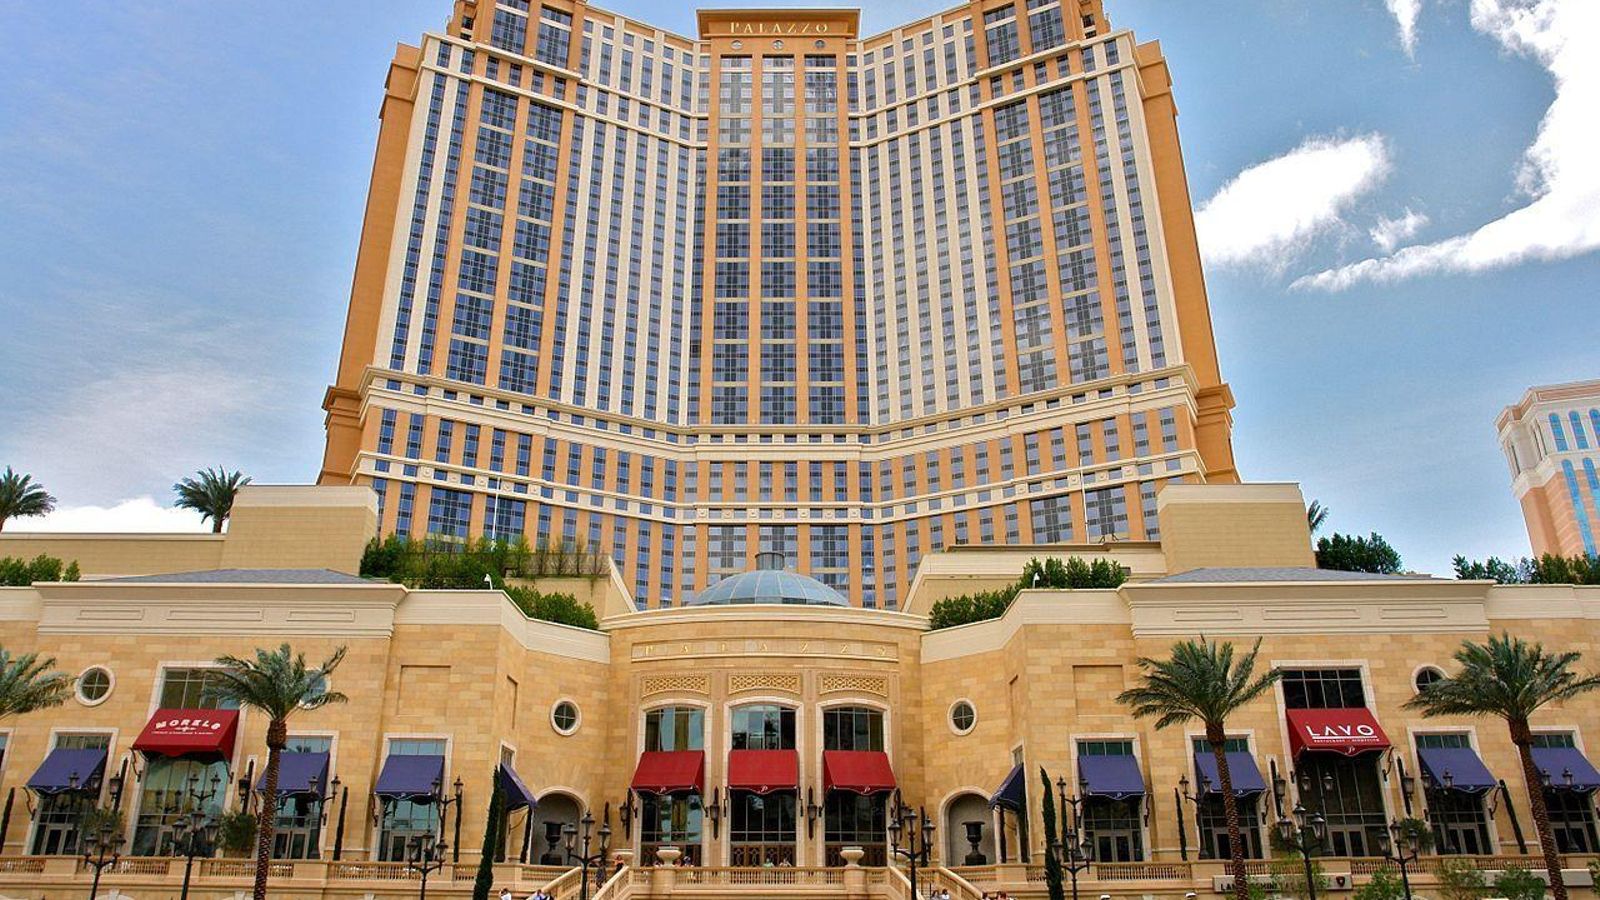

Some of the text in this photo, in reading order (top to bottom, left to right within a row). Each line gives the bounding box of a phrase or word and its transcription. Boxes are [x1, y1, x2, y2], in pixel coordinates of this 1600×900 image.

[730, 22, 828, 34] PALAZZO
[644, 642, 887, 656] PALAZZO
[1305, 724, 1374, 736] LAVO
